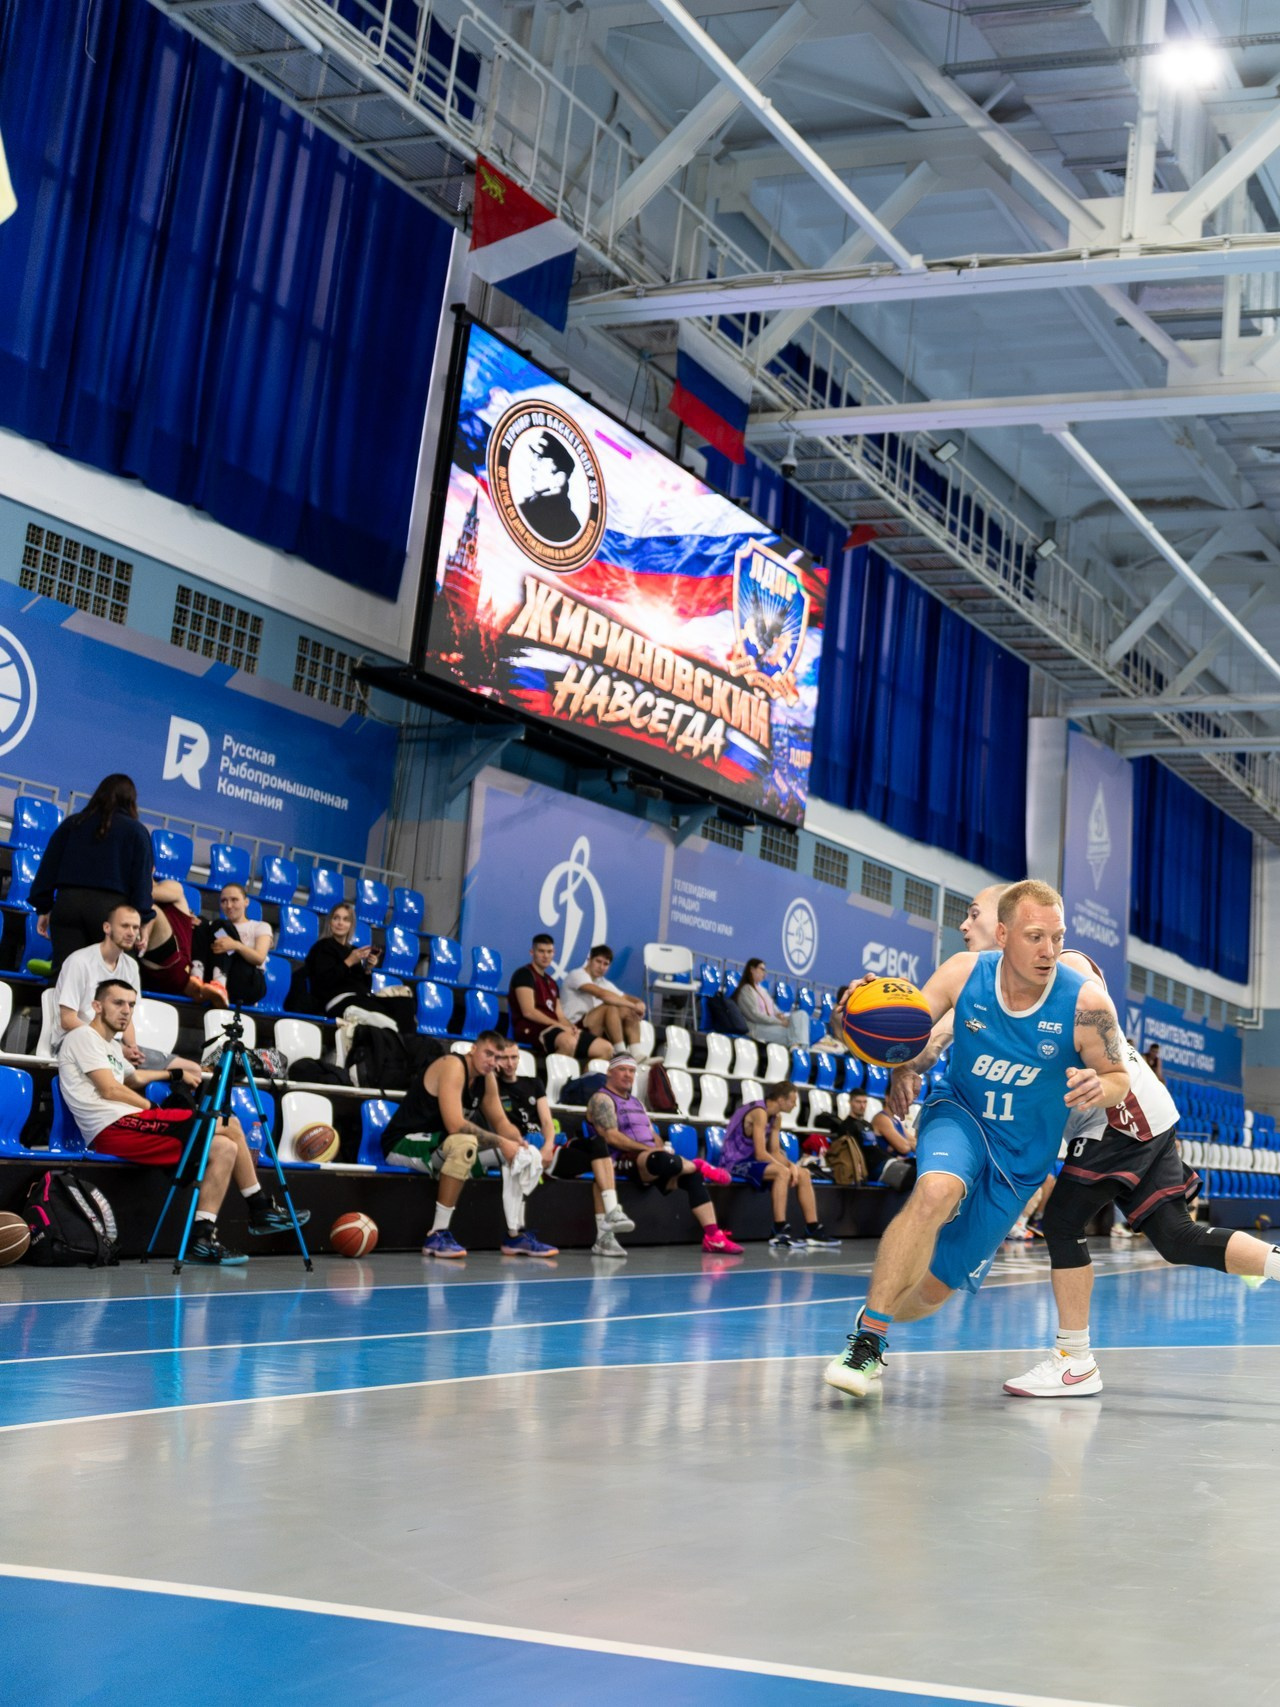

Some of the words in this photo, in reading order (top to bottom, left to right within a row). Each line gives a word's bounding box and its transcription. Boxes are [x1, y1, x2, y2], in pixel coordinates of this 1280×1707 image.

[531, 412, 546, 426] ПО
[507, 574, 771, 749] ЖИРИНОВСКИЙ
[552, 663, 727, 763] НАВСЕГДА
[223, 734, 276, 767] Русская
[217, 777, 284, 811] Компания
[219, 755, 349, 811] Рыбопромышленная
[673, 878, 718, 902] ТЕЛЕВИДЕНИЕ
[678, 897, 701, 913] РАДИО
[671, 911, 716, 933] ПРИМОРСКОГО
[716, 924, 734, 938] КРАЯ
[887, 948, 920, 985] ВСК
[1143, 1038, 1196, 1068] ПМОРСКОГО
[971, 1054, 1042, 1087] ВВГУ
[982, 1090, 1015, 1121] 11
